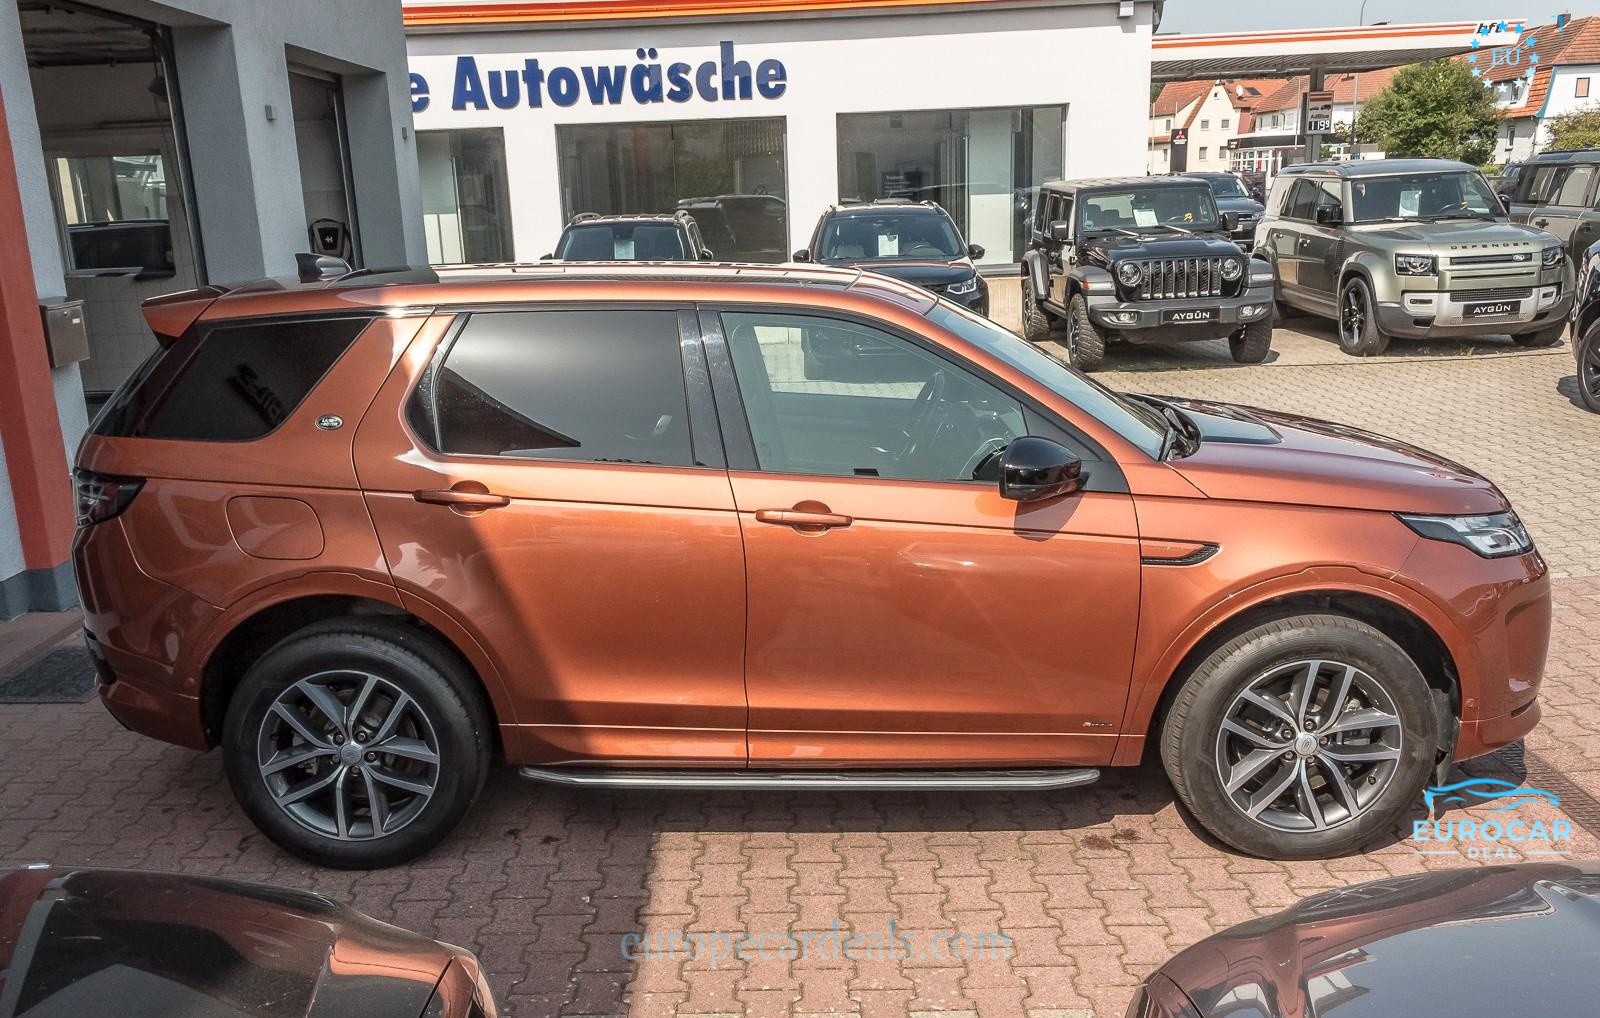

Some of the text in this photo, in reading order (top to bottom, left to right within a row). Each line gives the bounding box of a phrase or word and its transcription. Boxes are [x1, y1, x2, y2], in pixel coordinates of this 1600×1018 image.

[452, 41, 787, 111] Autowäsche
[1450, 242, 1530, 250] DEFENDER
[1473, 303, 1512, 314] AYGÜN
[1172, 310, 1210, 320] AYGÜN
